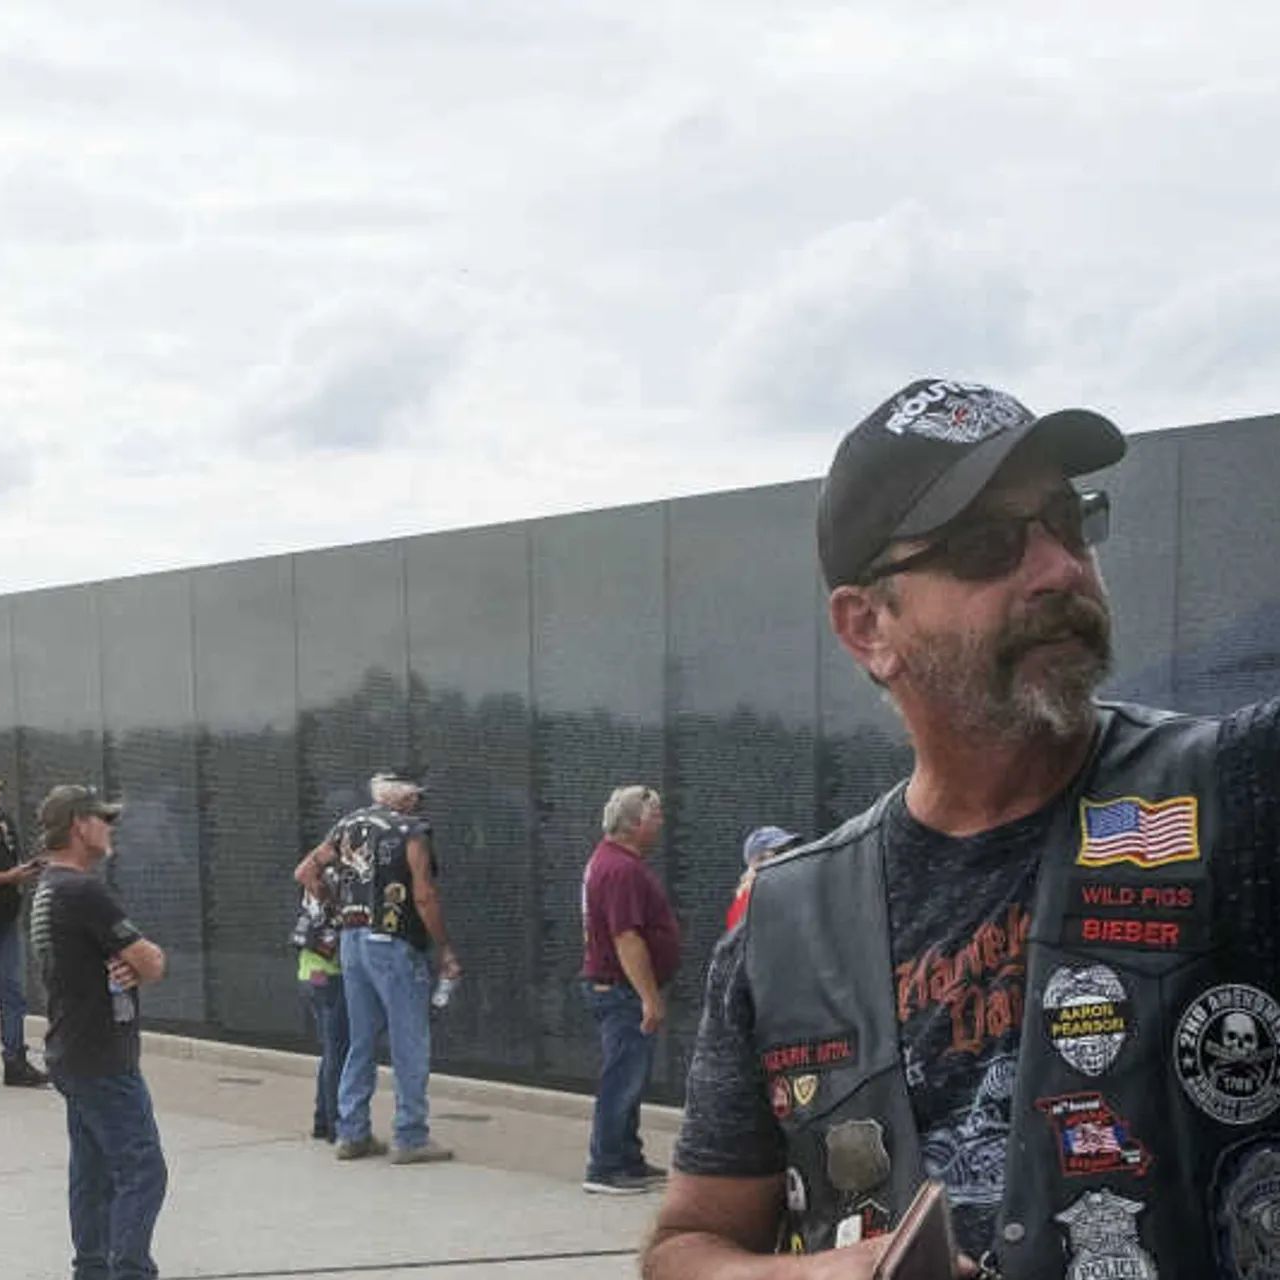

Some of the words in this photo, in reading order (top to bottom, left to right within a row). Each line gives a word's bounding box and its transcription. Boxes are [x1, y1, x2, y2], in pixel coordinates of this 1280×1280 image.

[1081, 886, 1136, 905] WILD
[1142, 887, 1193, 907] PIGS
[1082, 919, 1180, 944] BIEBER
